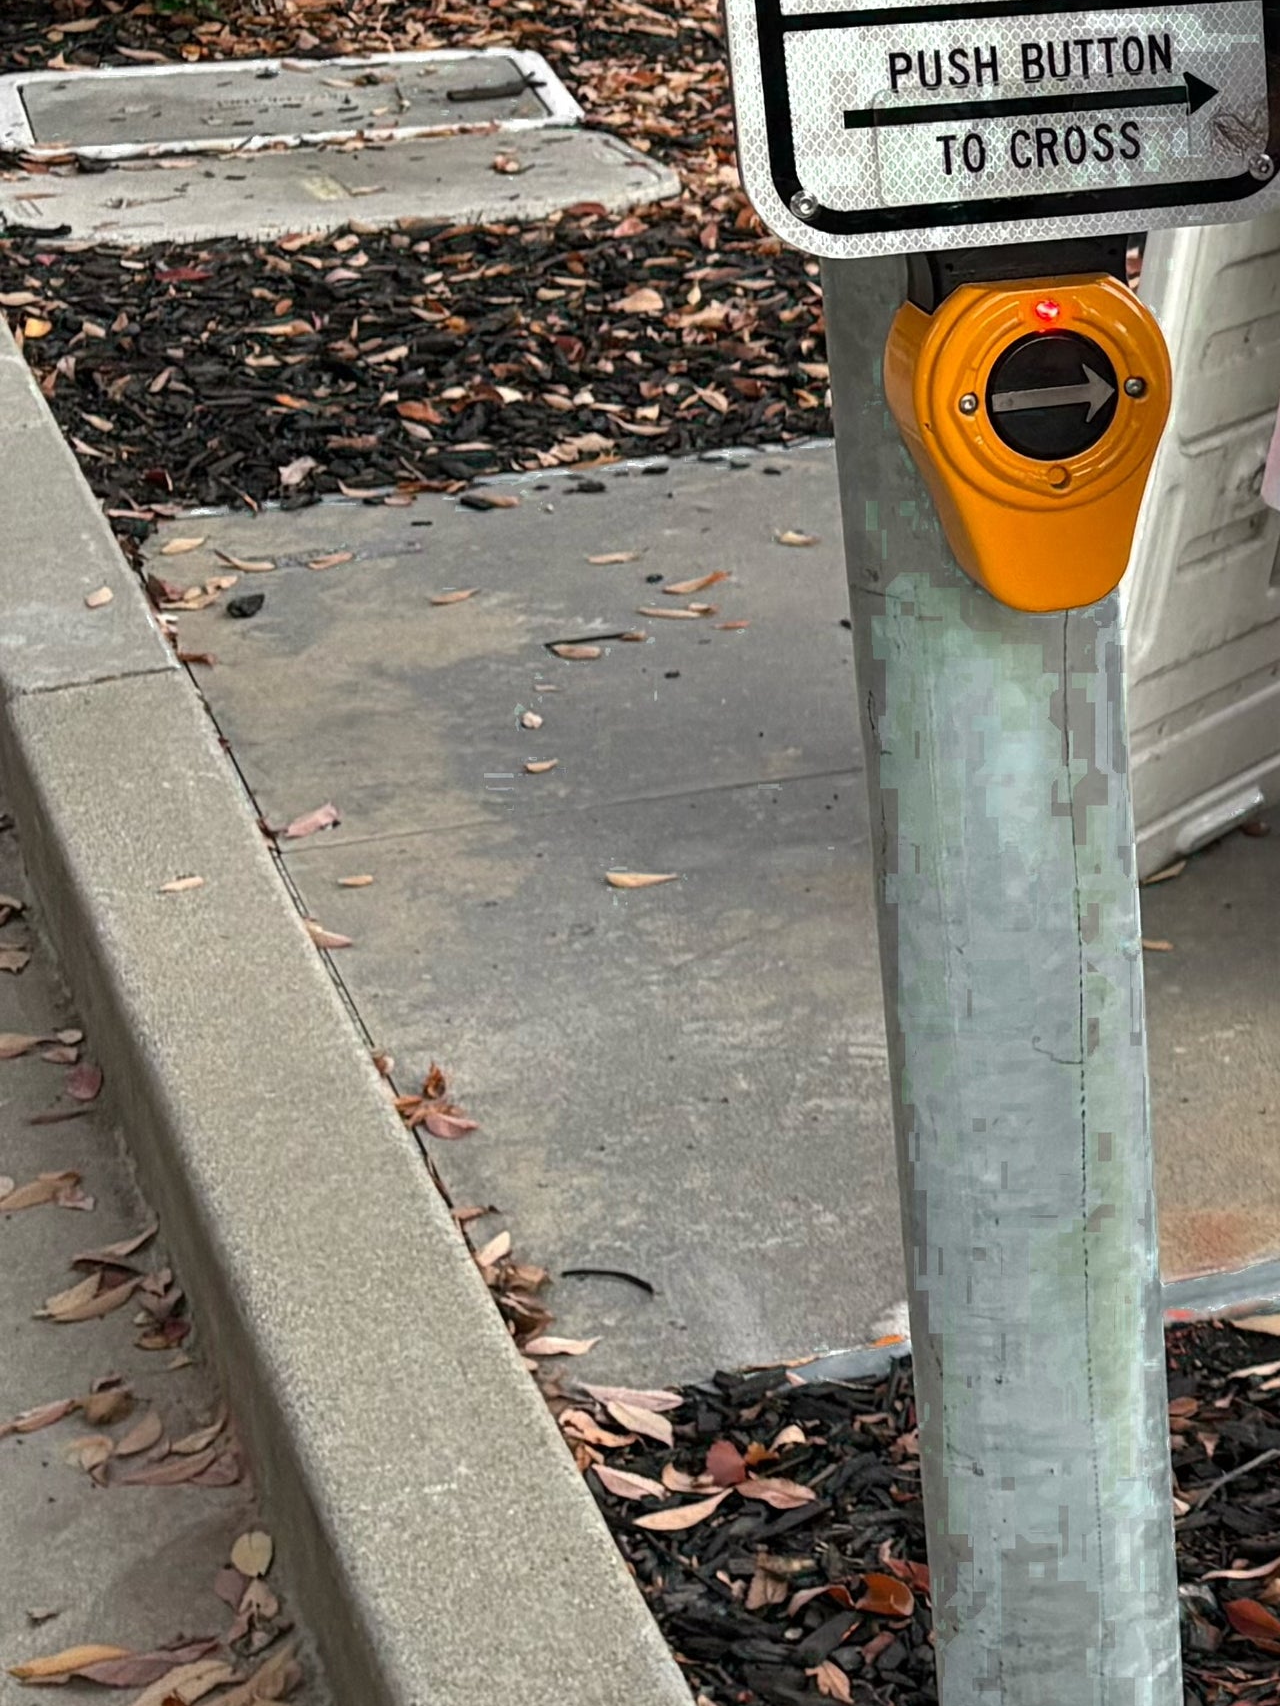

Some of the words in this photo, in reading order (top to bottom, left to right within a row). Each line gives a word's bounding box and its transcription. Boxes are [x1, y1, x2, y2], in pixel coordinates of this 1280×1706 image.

[888, 45, 1000, 94] PUSH
[1020, 32, 1173, 85] BUTTON
[935, 132, 987, 176] TO
[1009, 120, 1141, 170] CROSS
